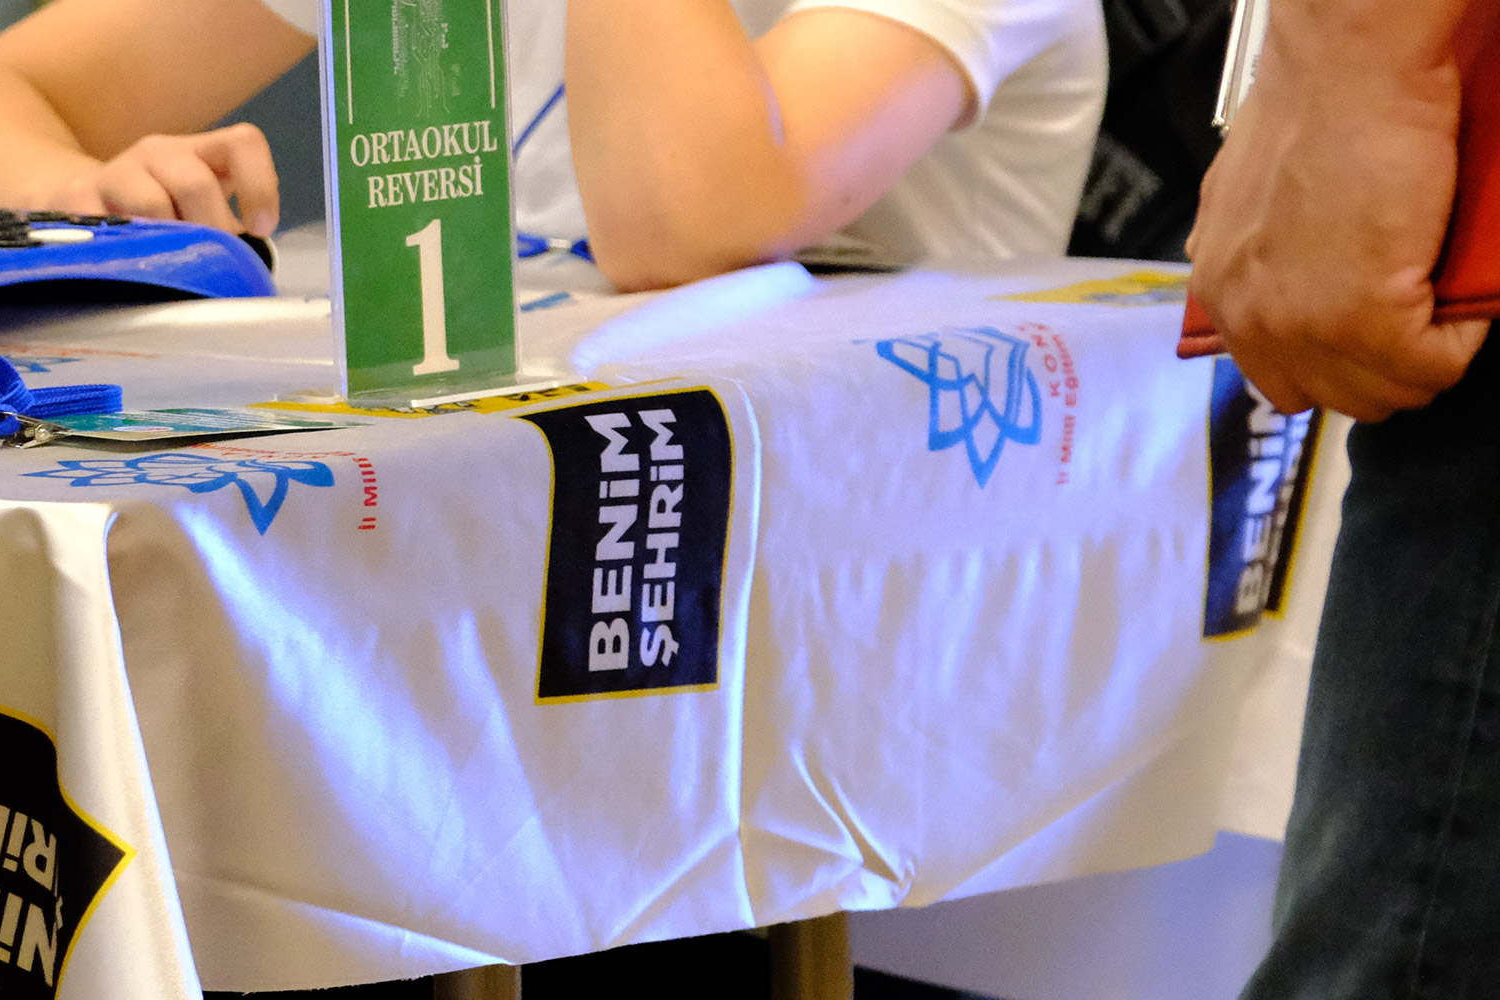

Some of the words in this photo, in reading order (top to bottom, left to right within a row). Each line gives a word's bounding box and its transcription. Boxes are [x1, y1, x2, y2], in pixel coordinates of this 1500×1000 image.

[350, 120, 498, 168] ORTAOKUL
[367, 156, 485, 209] REVERSİ
[405, 218, 461, 376] 1
